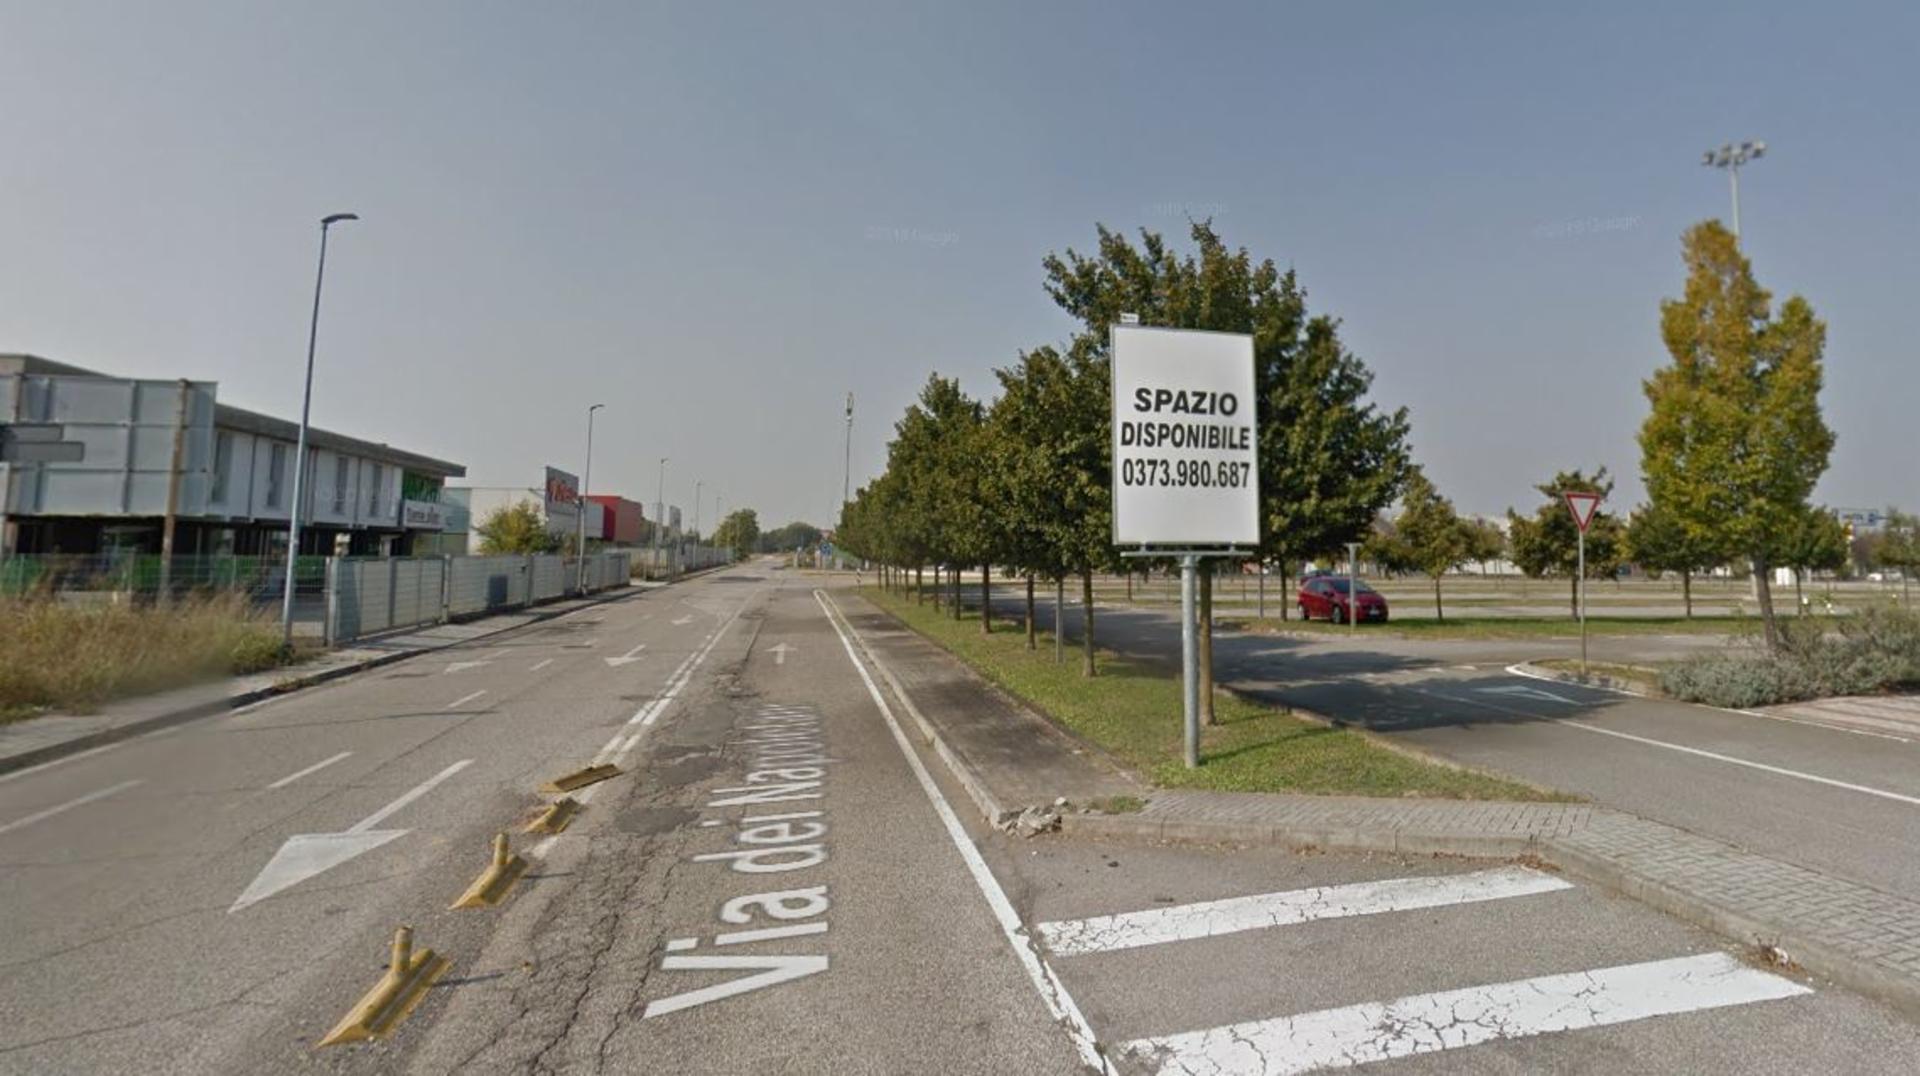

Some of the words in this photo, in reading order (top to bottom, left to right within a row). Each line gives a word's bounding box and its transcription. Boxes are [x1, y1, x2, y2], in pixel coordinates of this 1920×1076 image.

[1134, 387, 1238, 416] SPAZIO
[1121, 422, 1250, 451] DISPONIBILE
[1122, 457, 1250, 488] 0373.980.687
[692, 811, 828, 874] dei
[643, 885, 829, 1019] Via
